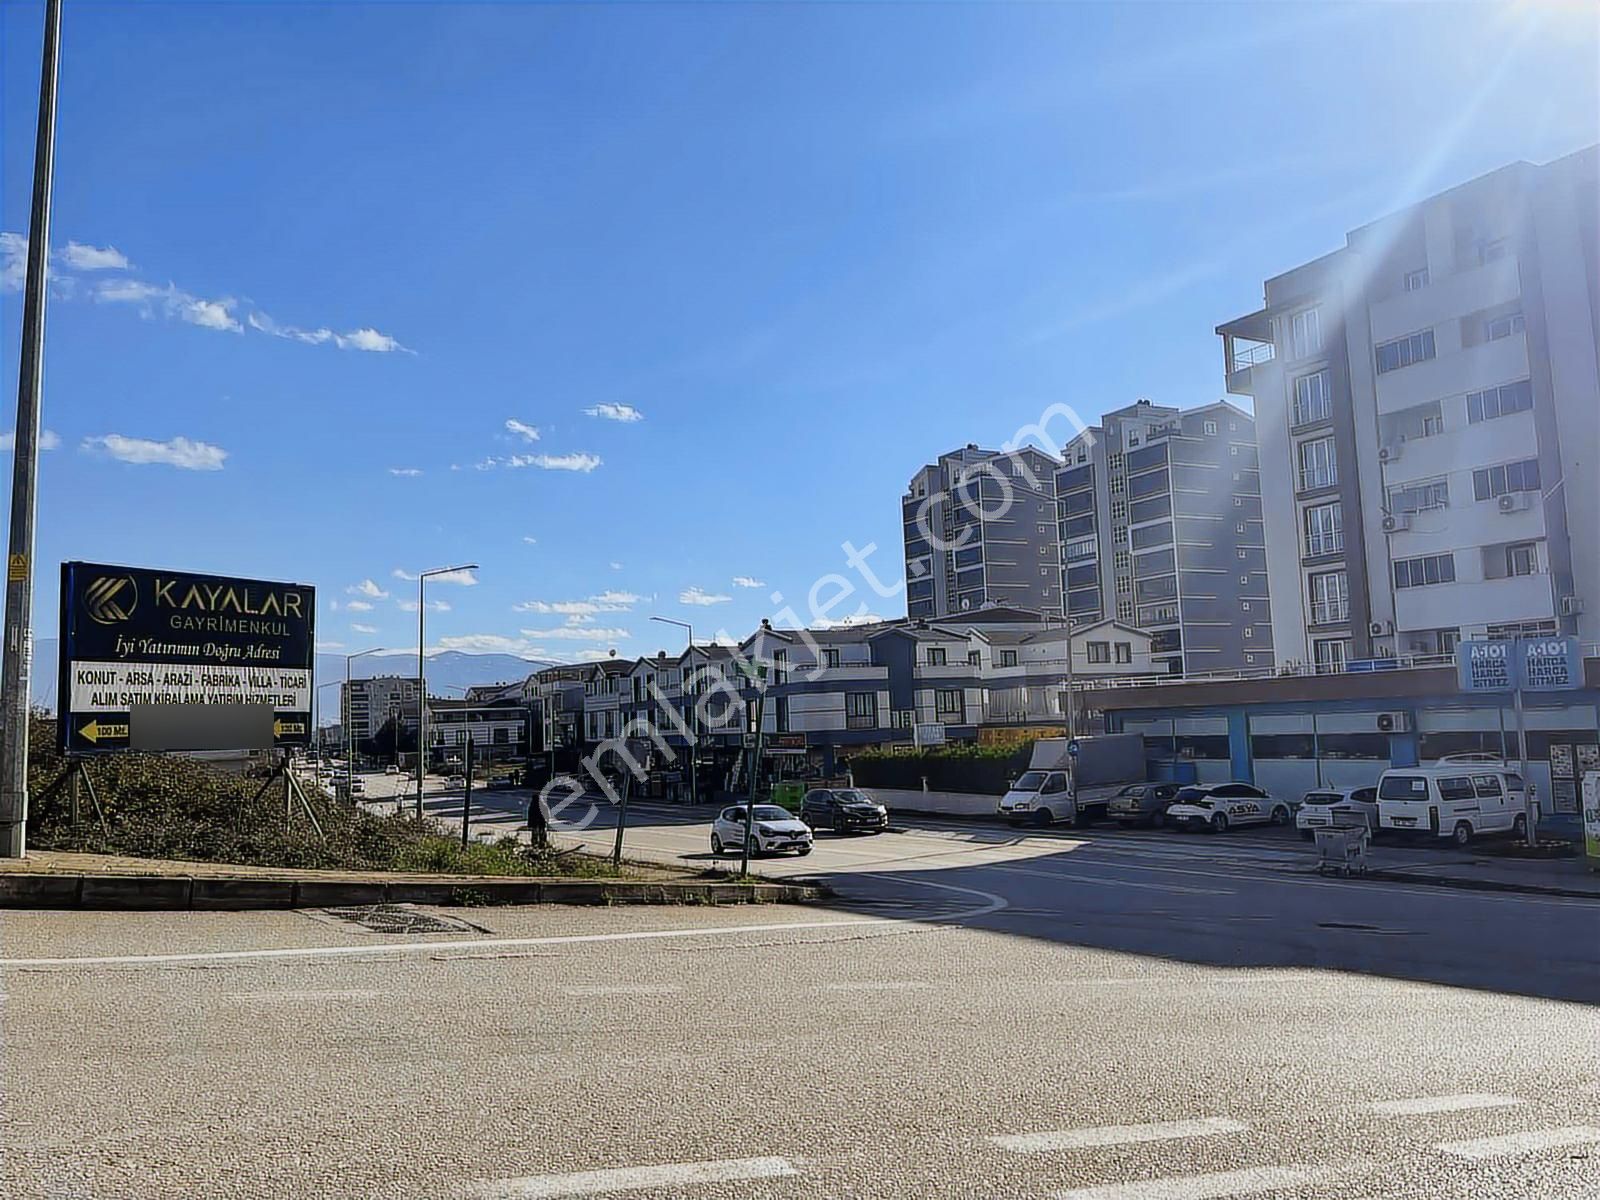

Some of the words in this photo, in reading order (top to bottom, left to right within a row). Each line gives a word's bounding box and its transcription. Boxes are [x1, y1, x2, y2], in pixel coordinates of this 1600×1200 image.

[155, 578, 303, 618] KAYALAR
[170, 615, 291, 637] GAYRİMENKUL
[242, 644, 281, 660] Adresi
[77, 670, 117, 685] KONUT
[125, 672, 154, 685] ARSA
[91, 692, 118, 706] ALIM
[120, 692, 151, 706] SATIM
